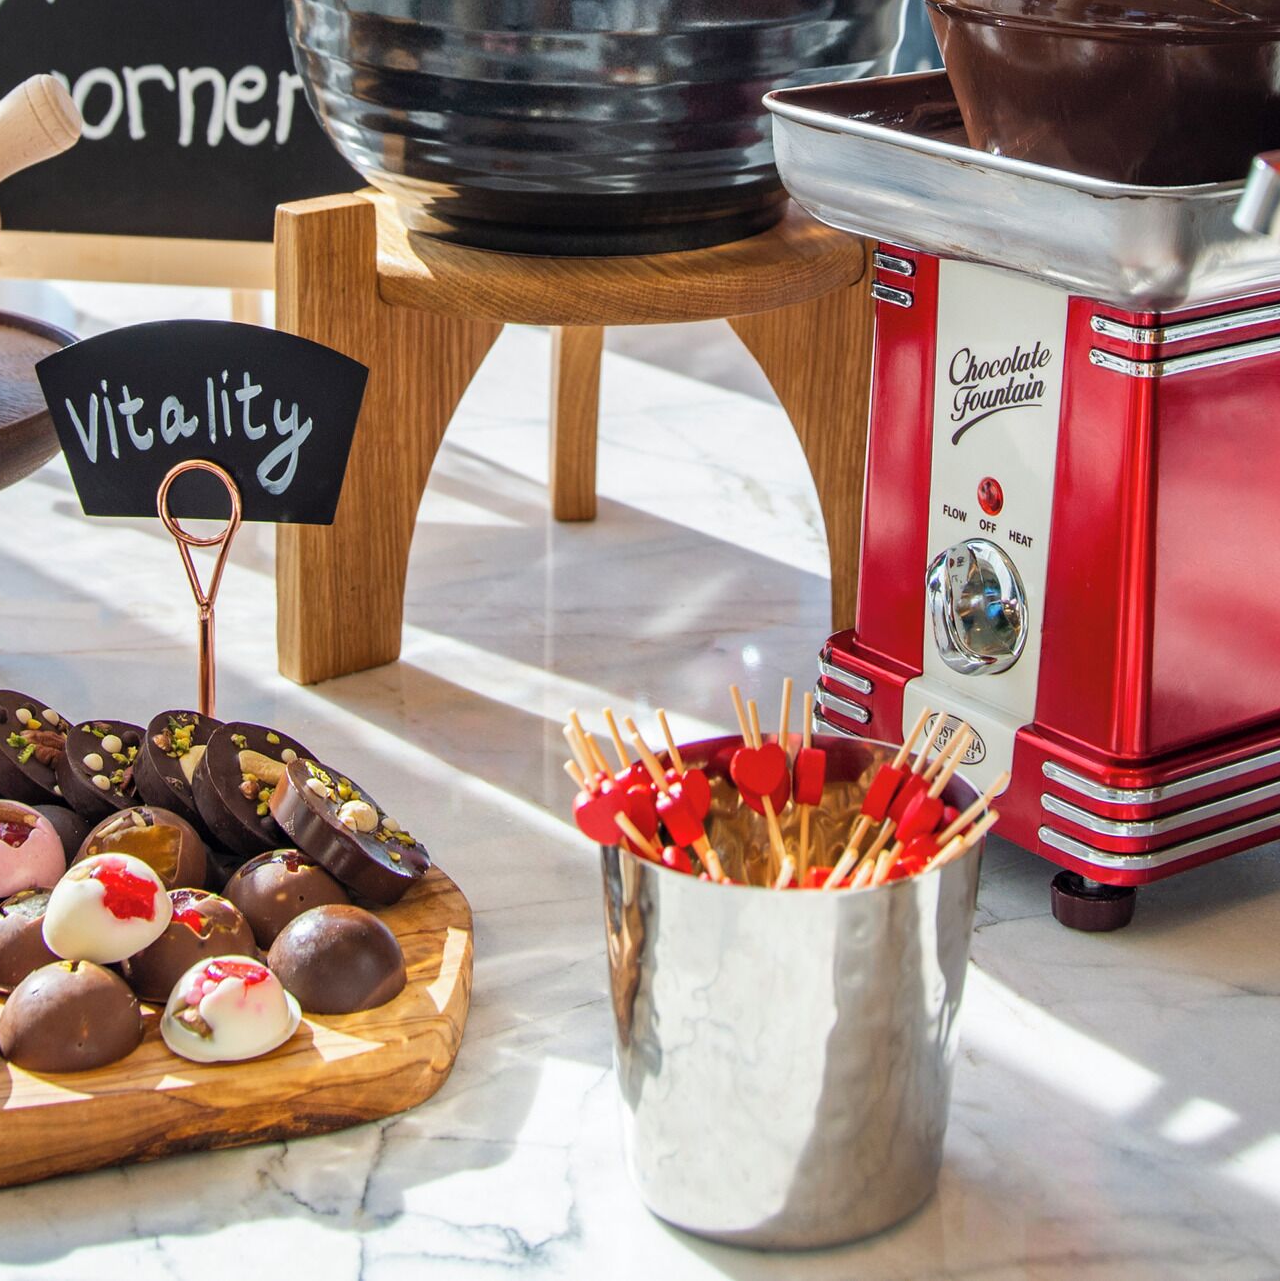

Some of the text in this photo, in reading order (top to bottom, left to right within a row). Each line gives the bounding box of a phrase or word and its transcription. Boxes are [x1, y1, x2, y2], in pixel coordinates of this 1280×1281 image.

[948, 340, 1053, 386] Chocolate
[950, 372, 1047, 422] Fountain
[64, 369, 313, 496] Vitality
[942, 504, 1034, 549] FLOW OFF HEAT
